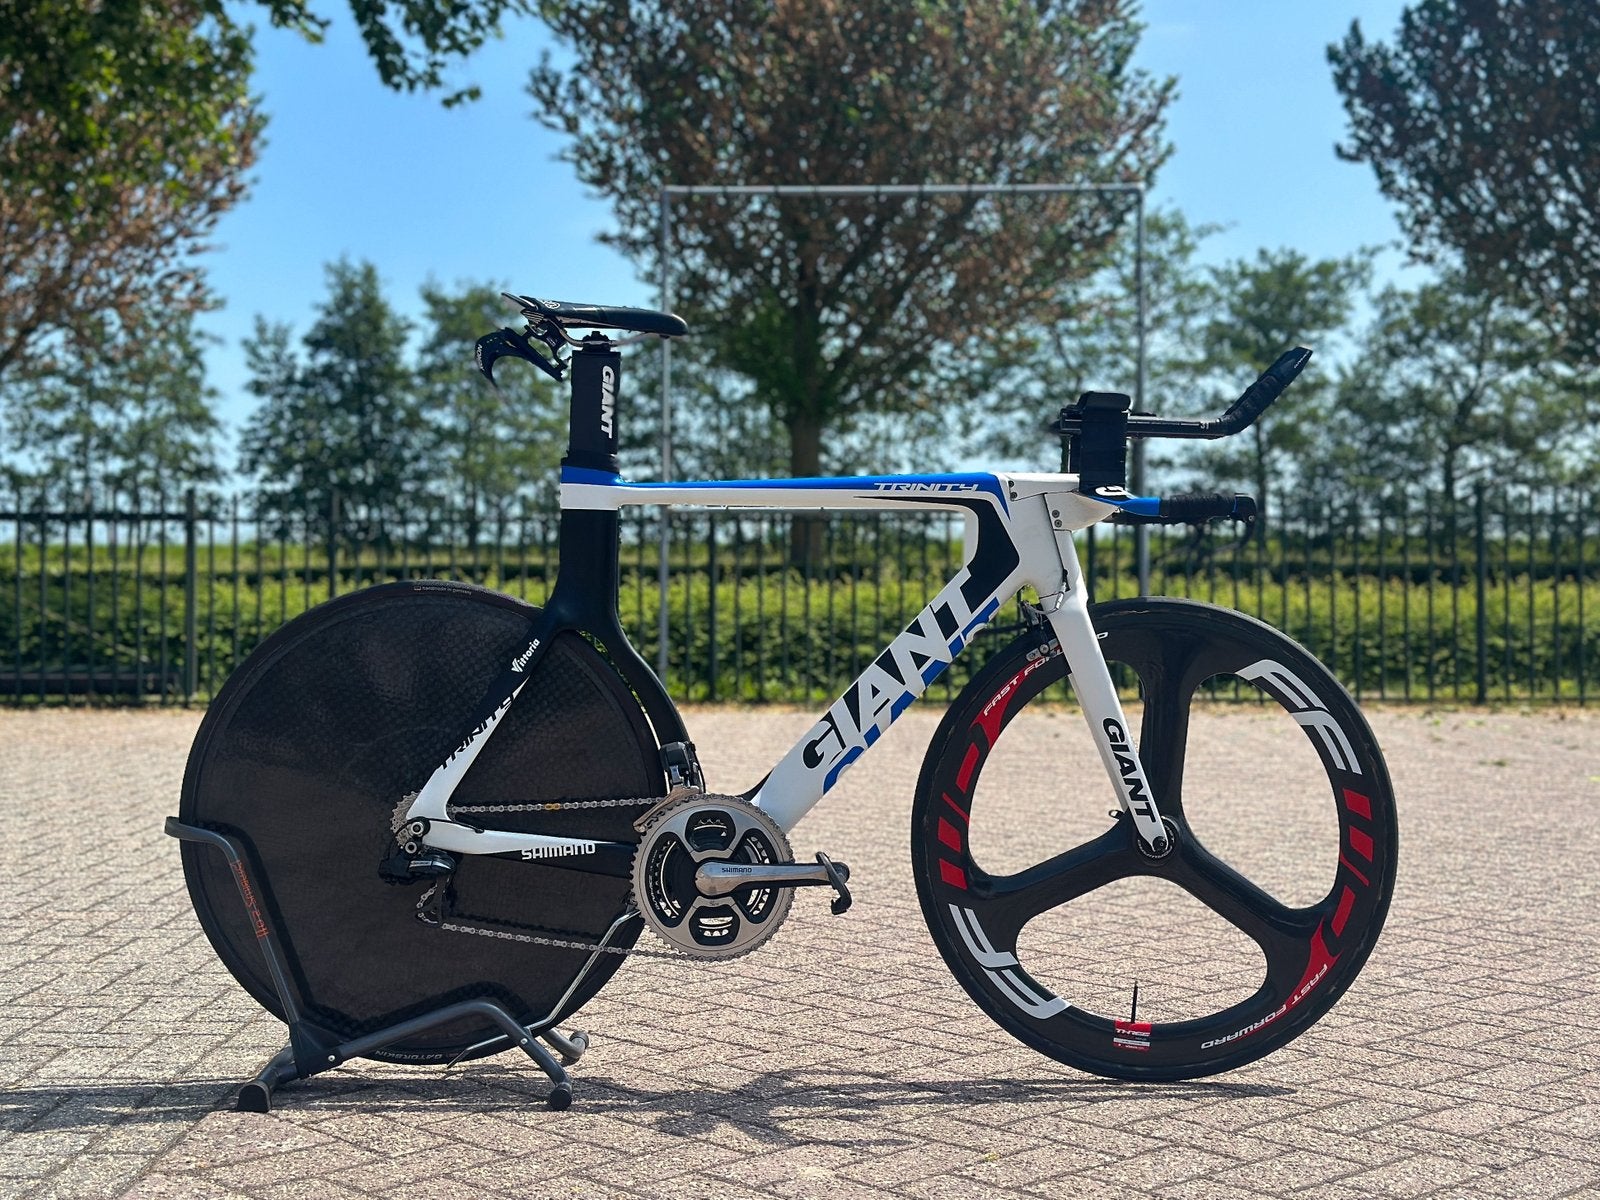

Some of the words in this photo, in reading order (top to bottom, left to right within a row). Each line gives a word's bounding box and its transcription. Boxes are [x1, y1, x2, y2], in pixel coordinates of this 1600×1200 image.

[600, 365, 615, 439] GIANT
[873, 482, 979, 493] TRINITY
[510, 637, 541, 673] Vittoria
[798, 563, 978, 775] GIANT
[983, 675, 1020, 717] FAST
[438, 694, 515, 772] TRINITY
[1102, 717, 1157, 823] GIANT
[521, 842, 597, 860] SHIMANO
[721, 866, 753, 874] SHIMANO
[1291, 963, 1328, 1005] FAST
[1200, 1003, 1287, 1050] FORWARD
